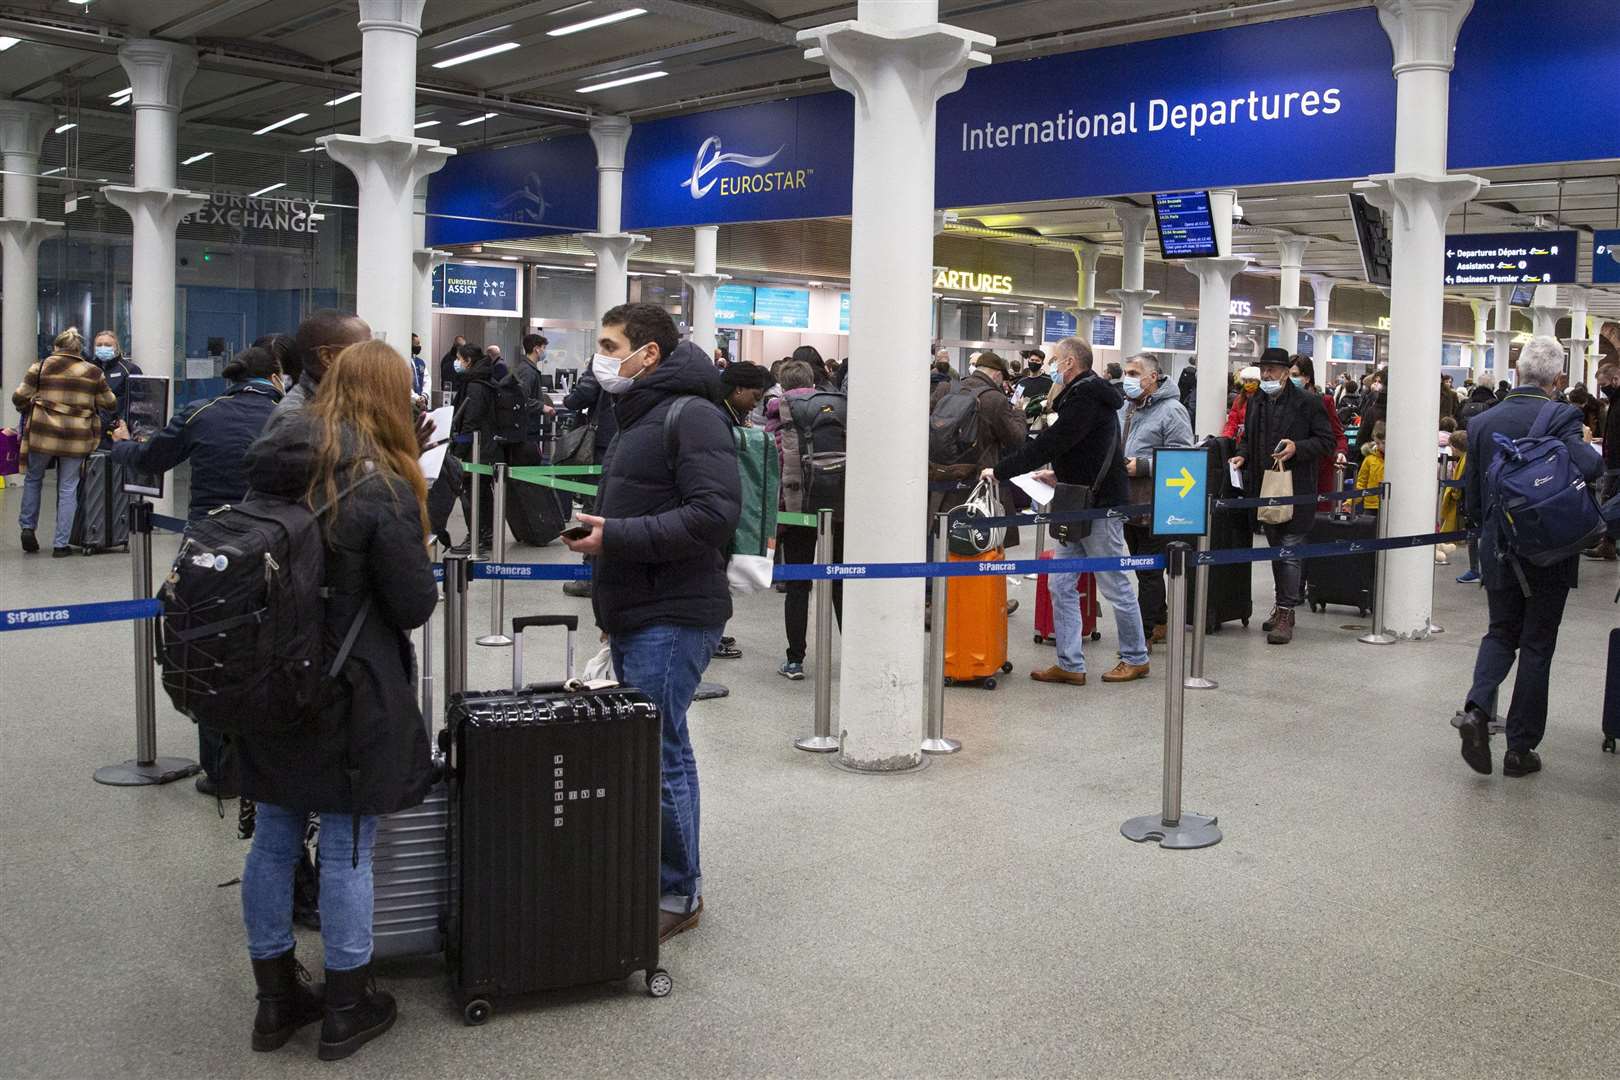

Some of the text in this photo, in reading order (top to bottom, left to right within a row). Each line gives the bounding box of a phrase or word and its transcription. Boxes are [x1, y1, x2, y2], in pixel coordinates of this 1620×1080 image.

[962, 88, 1341, 151] International Departures
[720, 170, 806, 196] EUROSTAR
[195, 206, 319, 233] EXCHANGE
[1457, 248, 1527, 258] Departures Départs
[1457, 262, 1495, 270] Assistance
[448, 278, 477, 286] EUROSTAR
[1456, 275, 1519, 284] Business Premier
[447, 285, 478, 295] ASSIST
[987, 311, 999, 333] 4
